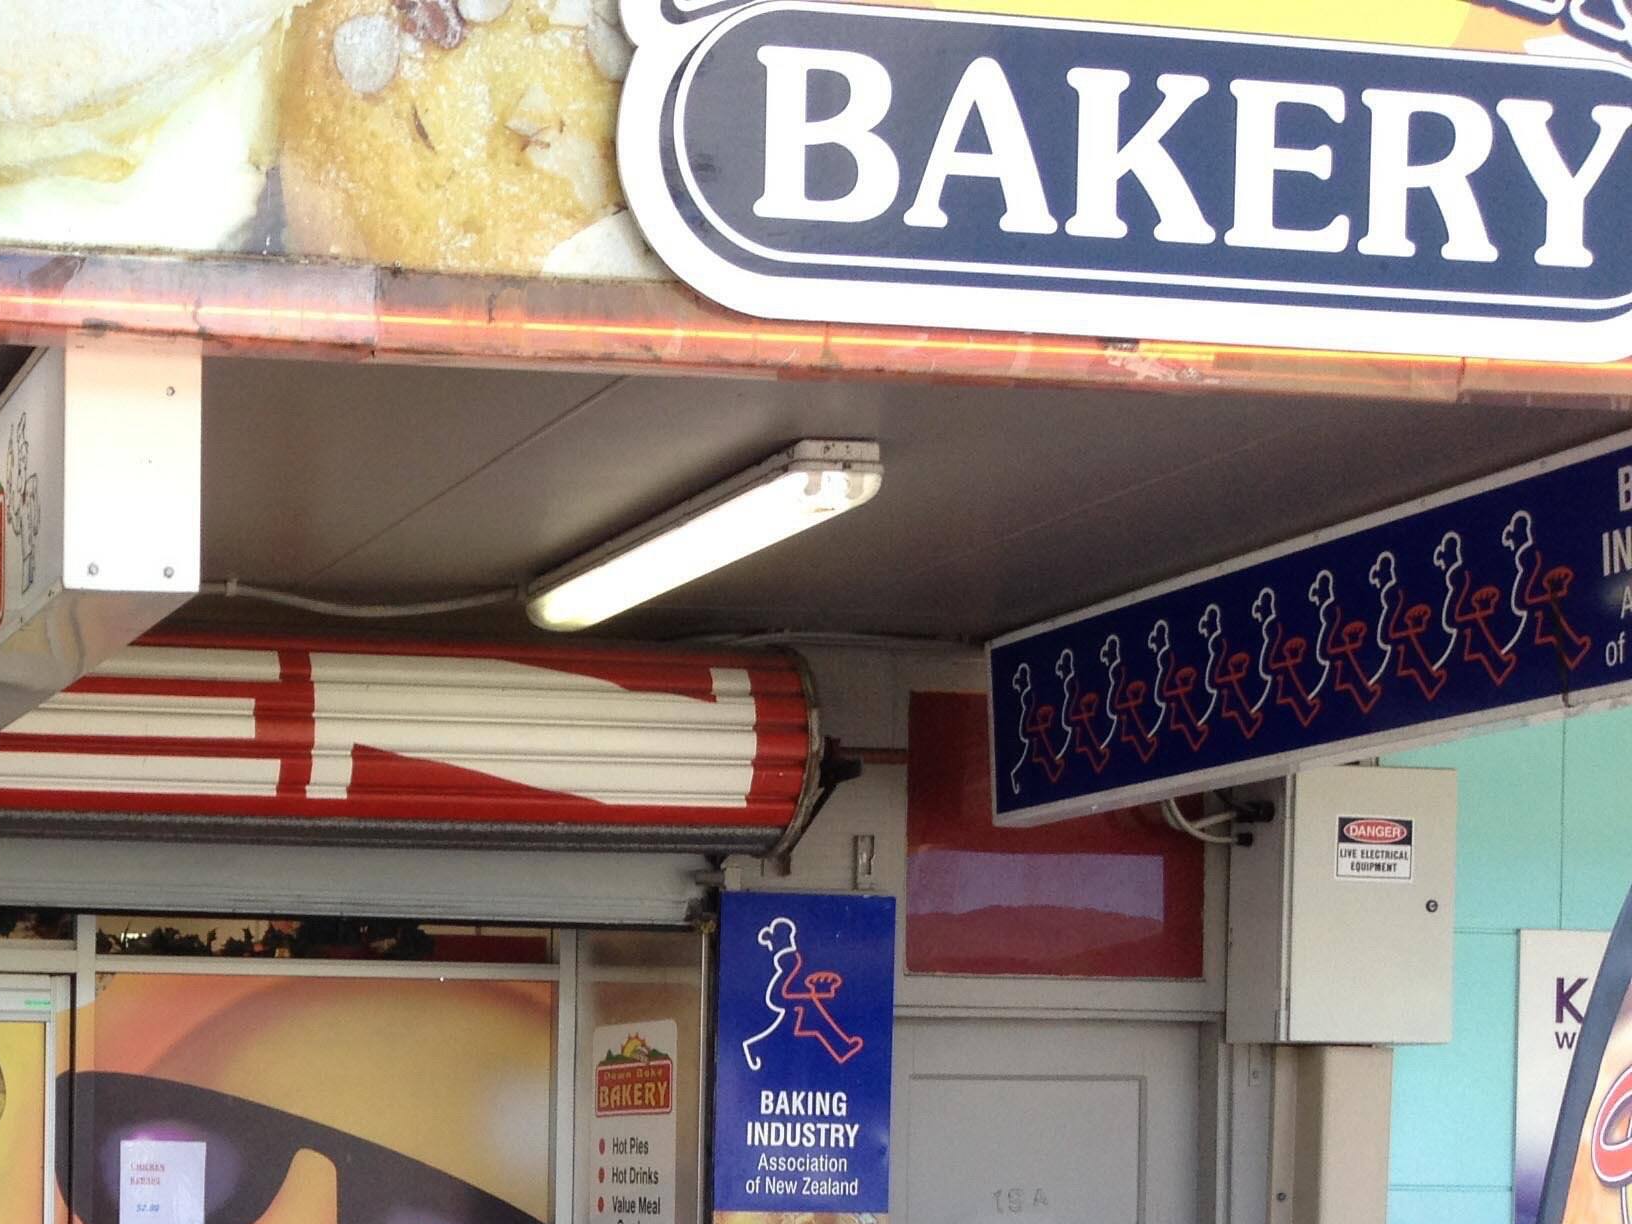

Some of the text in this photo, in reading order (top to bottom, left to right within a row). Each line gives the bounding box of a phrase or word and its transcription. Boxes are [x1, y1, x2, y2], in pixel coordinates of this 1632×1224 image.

[752, 44, 1632, 270] BAKERY
[1349, 825, 1401, 838] DANGER
[1340, 848, 1409, 861] LIVE ELECTRICAL
[1350, 861, 1398, 872] EQUIPMENT
[598, 1080, 668, 1109] BAKERY
[760, 1090, 847, 1116] BAKING
[746, 1122, 859, 1149] INDUSTRY
[612, 1137, 649, 1155] Hot Pies
[757, 1153, 848, 1173] Association
[612, 1167, 660, 1186] Hot Drinks
[745, 1177, 859, 1197] of New Zealand
[612, 1196, 661, 1215] Value Meal
